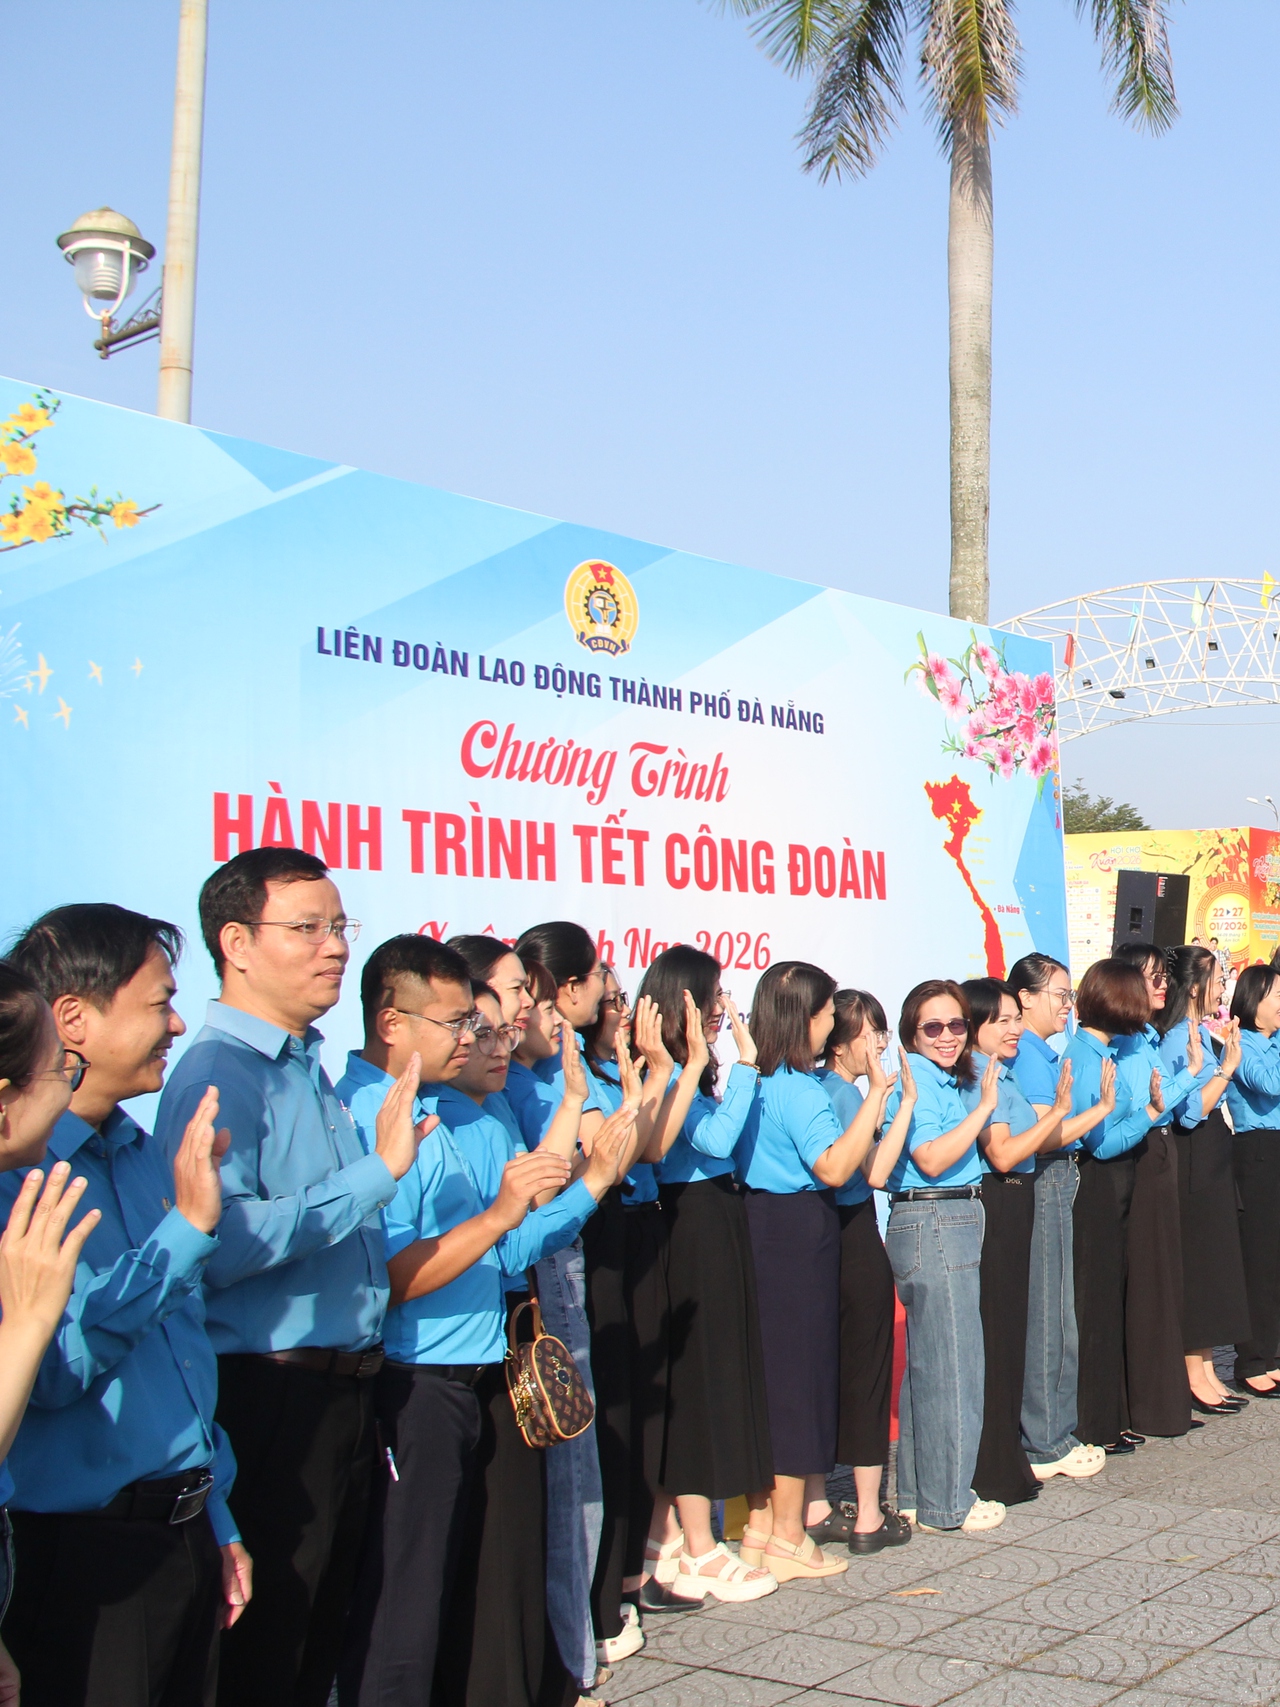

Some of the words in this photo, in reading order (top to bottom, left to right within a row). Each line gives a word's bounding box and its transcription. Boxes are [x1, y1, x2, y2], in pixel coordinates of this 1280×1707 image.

[317, 625, 383, 664] LIÊN
[392, 641, 470, 679] ĐOÀN
[479, 655, 526, 687] LAO
[534, 662, 601, 699] ĐỘNG
[609, 676, 683, 712] THÀNH
[690, 689, 731, 720] PHỐ
[737, 697, 765, 725] ĐÀ
[771, 700, 825, 735] NẴNG
[460, 719, 618, 806] Chương
[629, 741, 731, 803] Trình
[213, 780, 383, 872] HÀNH
[401, 801, 557, 882] TRÌNH
[572, 808, 650, 887] TẾT
[665, 823, 776, 895] CÔNG
[787, 836, 887, 901] ĐOÀN
[997, 904, 1005, 913] Đà
[1209, 921, 1248, 931] 01/2026
[1213, 907, 1225, 917] 22
[1232, 907, 1244, 917] 27
[696, 930, 771, 971] 2026
